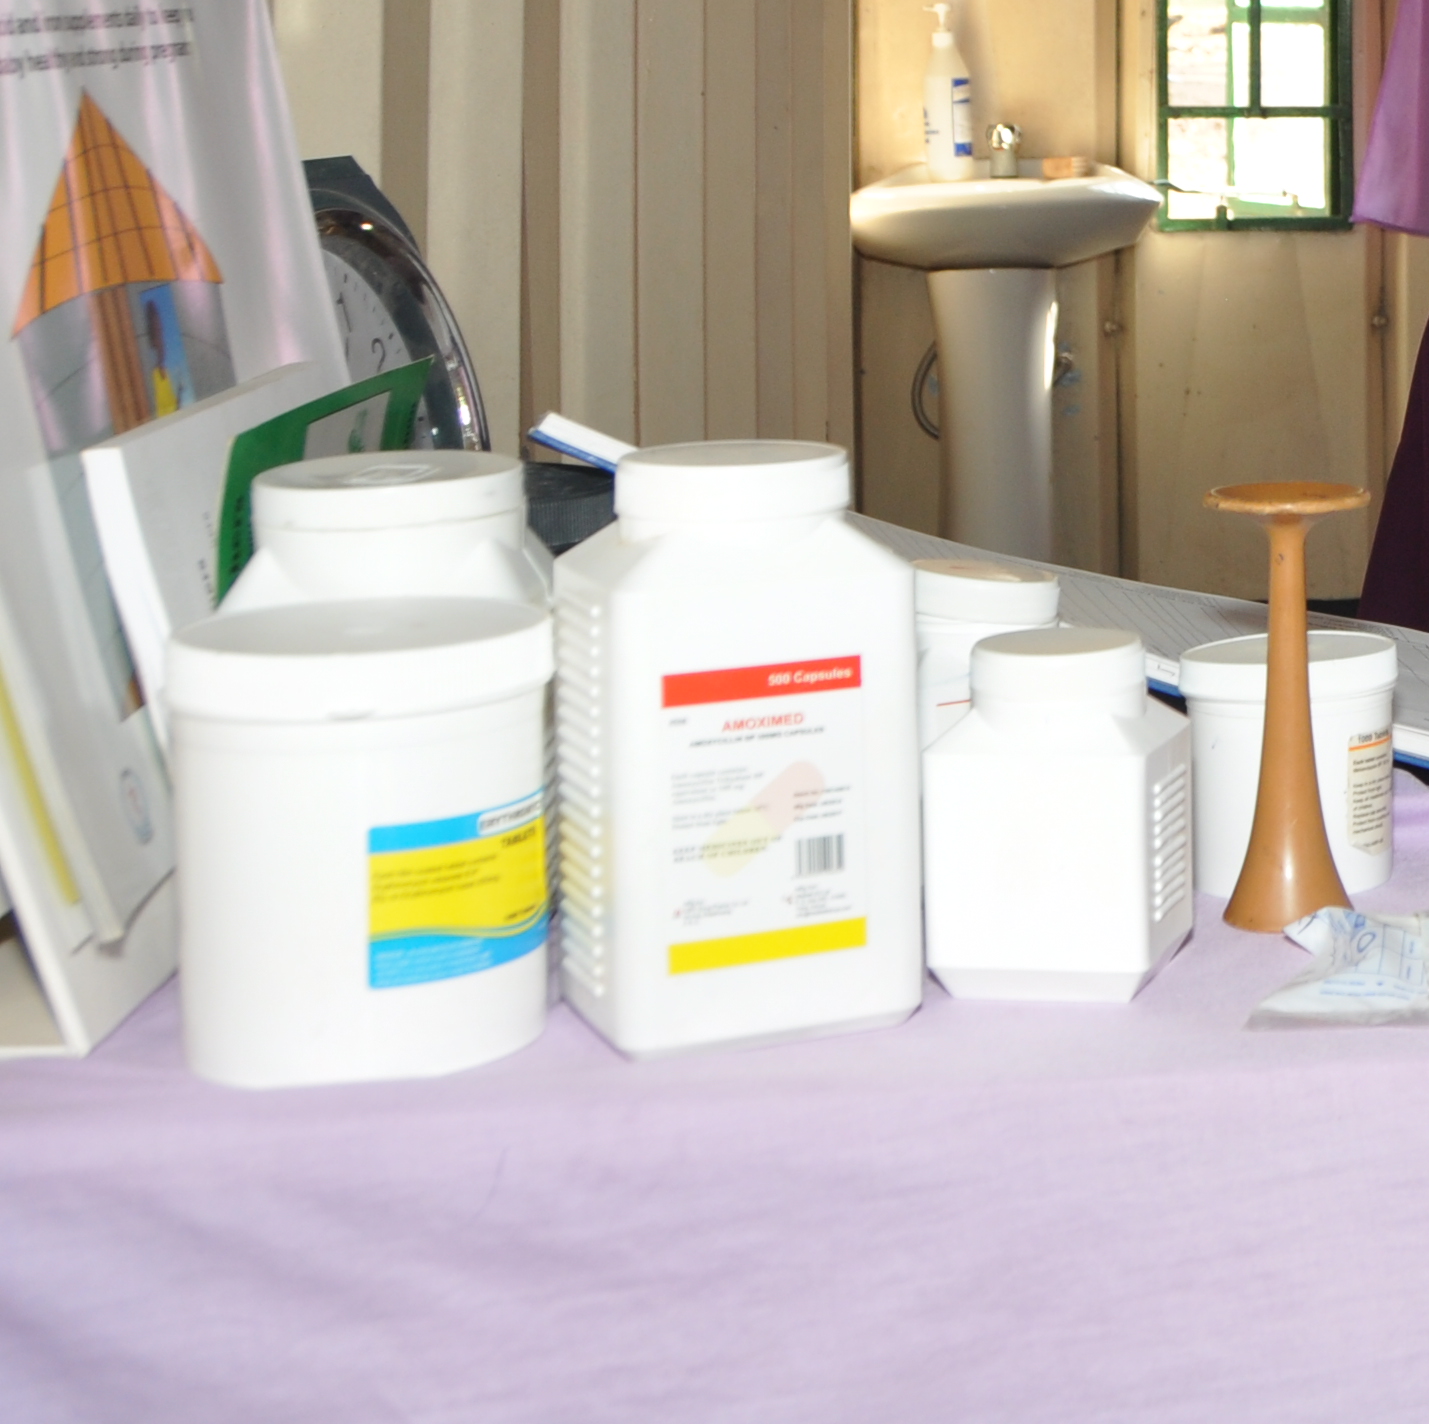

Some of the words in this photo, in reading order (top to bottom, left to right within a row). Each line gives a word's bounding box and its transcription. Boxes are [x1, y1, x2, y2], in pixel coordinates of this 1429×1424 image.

[767, 671, 791, 687] 500
[793, 666, 853, 685] Capsules
[721, 712, 805, 733] AMOXIMED
